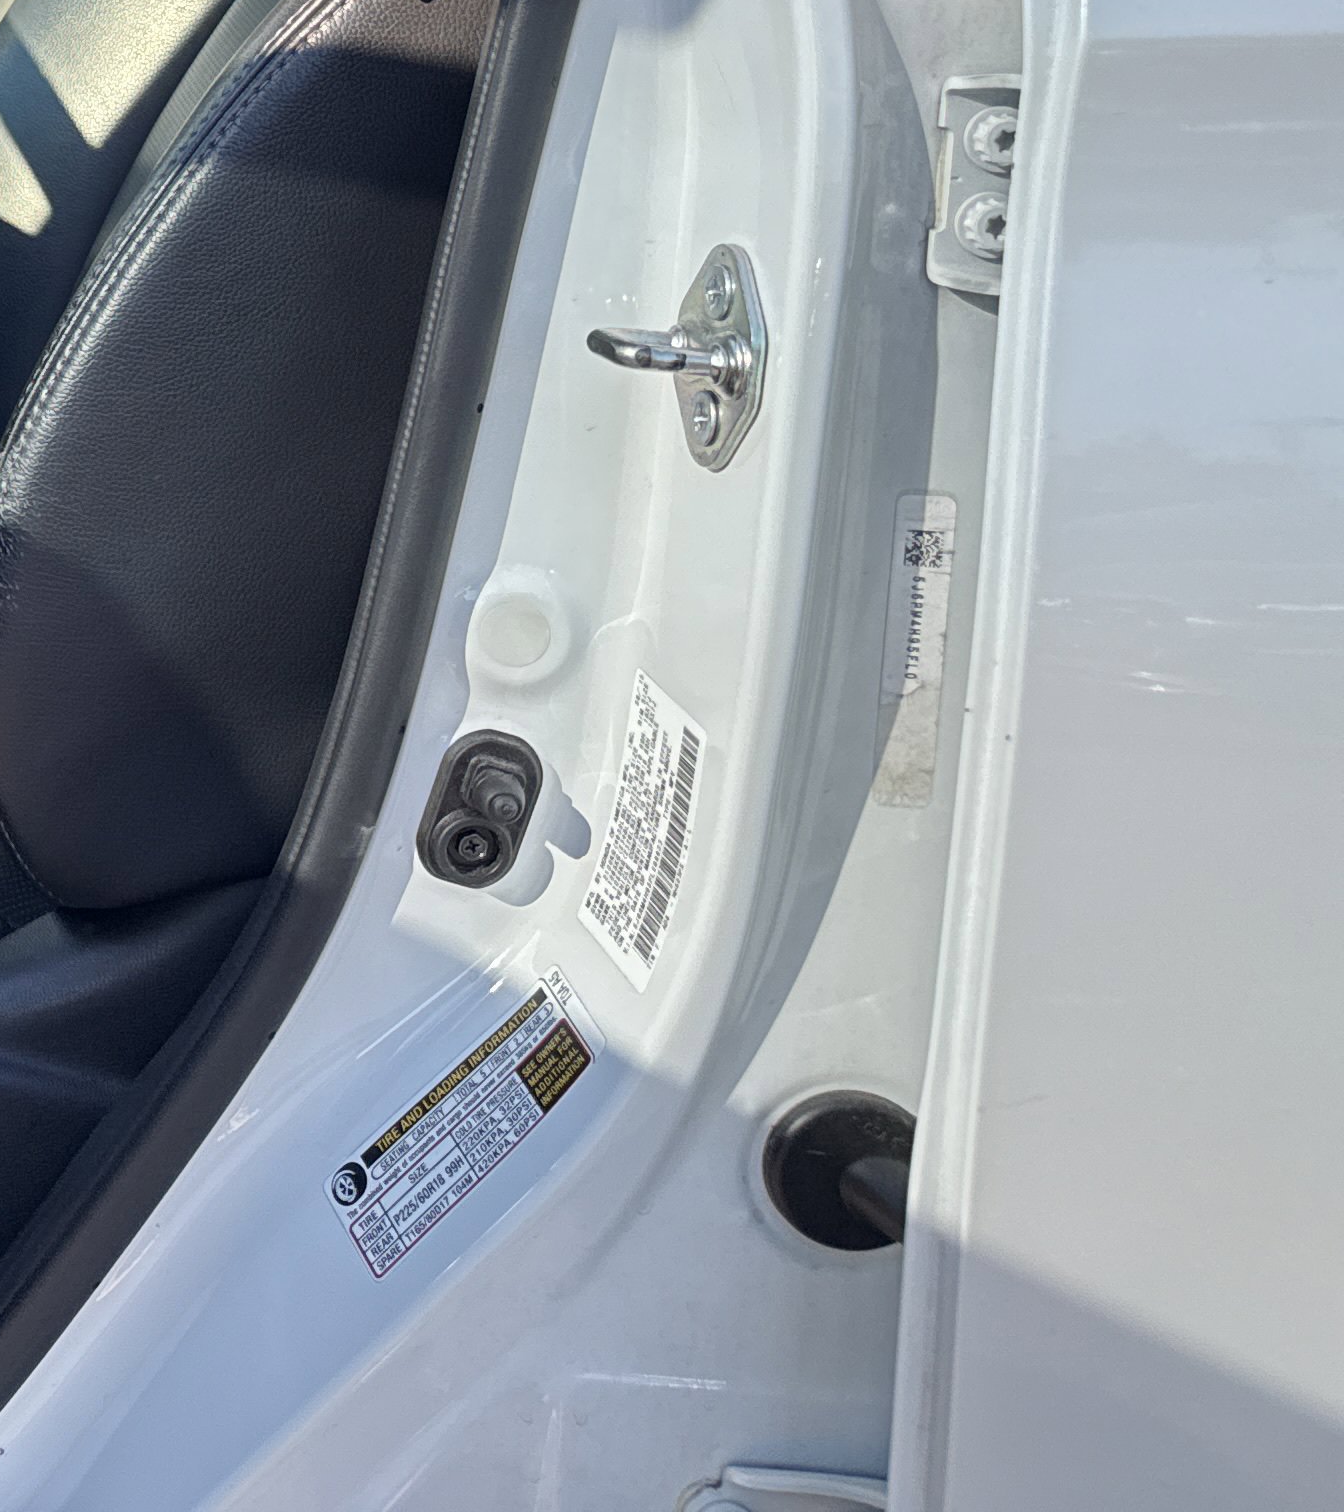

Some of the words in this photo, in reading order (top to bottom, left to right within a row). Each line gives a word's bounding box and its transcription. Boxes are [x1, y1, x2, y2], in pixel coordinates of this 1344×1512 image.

[599, 843, 611, 867] HONDA
[613, 786, 624, 821] AMERICA
[605, 905, 616, 924] THIS
[615, 865, 629, 899] VEHICLE
[628, 818, 641, 858] CONFORMS
[646, 723, 658, 773] APPLICABLE
[621, 896, 632, 919] THEFT
[631, 838, 648, 889] PREVENTION
[647, 785, 659, 831] STANDARDS
[659, 732, 667, 762] EFFECT
[608, 901, 624, 935] FEDERAL
[623, 870, 634, 895] MOTOR
[633, 829, 645, 863] VEHICLE
[643, 791, 652, 820] SAFETY
[623, 916, 631, 930] THE
[630, 891, 640, 910] DATE
[643, 812, 659, 868] MANUFACTURE
[657, 779, 665, 804] SHOWN
[523, 1014, 542, 1034] REAR
[543, 1007, 549, 1015] 3
[375, 1126, 400, 1153] TIRE
[399, 1104, 423, 1131] AND
[422, 1062, 468, 1111] LOADING
[467, 998, 537, 1068] INFORMATION
[489, 1044, 511, 1068] FRONT
[512, 1036, 520, 1046] 2
[521, 1059, 537, 1078] SEE
[534, 1027, 568, 1064] OWNER'S
[527, 1053, 559, 1088] MANUAL
[556, 1037, 573, 1055] FOR
[532, 1046, 580, 1096] ADDITIONAL
[456, 1077, 477, 1100] TOTAL
[478, 1068, 486, 1078] 5
[498, 1087, 524, 1115] 32PSI
[538, 1054, 586, 1107] INFORMATION
[454, 1120, 472, 1140] COLD
[472, 1107, 486, 1123] TIRE
[485, 1077, 518, 1111] PRESSURE
[505, 1098, 531, 1126] 30PSI
[512, 1109, 539, 1137] 60PSI
[379, 1139, 409, 1172] SEATING
[411, 1106, 445, 1142] CAPACITY
[346, 1207, 358, 1220] The
[357, 1182, 383, 1210] combined
[382, 1165, 402, 1187] weight
[435, 1124, 446, 1137] and
[392, 1171, 445, 1228] P225/60R18
[444, 1154, 464, 1178] 99H
[407, 1162, 427, 1184] SIZE
[358, 1210, 378, 1232] TIRE
[361, 1218, 388, 1247] FRONT
[405, 1196, 450, 1243] T165/80D17
[451, 1174, 473, 1198] 104M
[370, 1232, 393, 1258] REAR
[376, 1243, 402, 1272] SPARE
